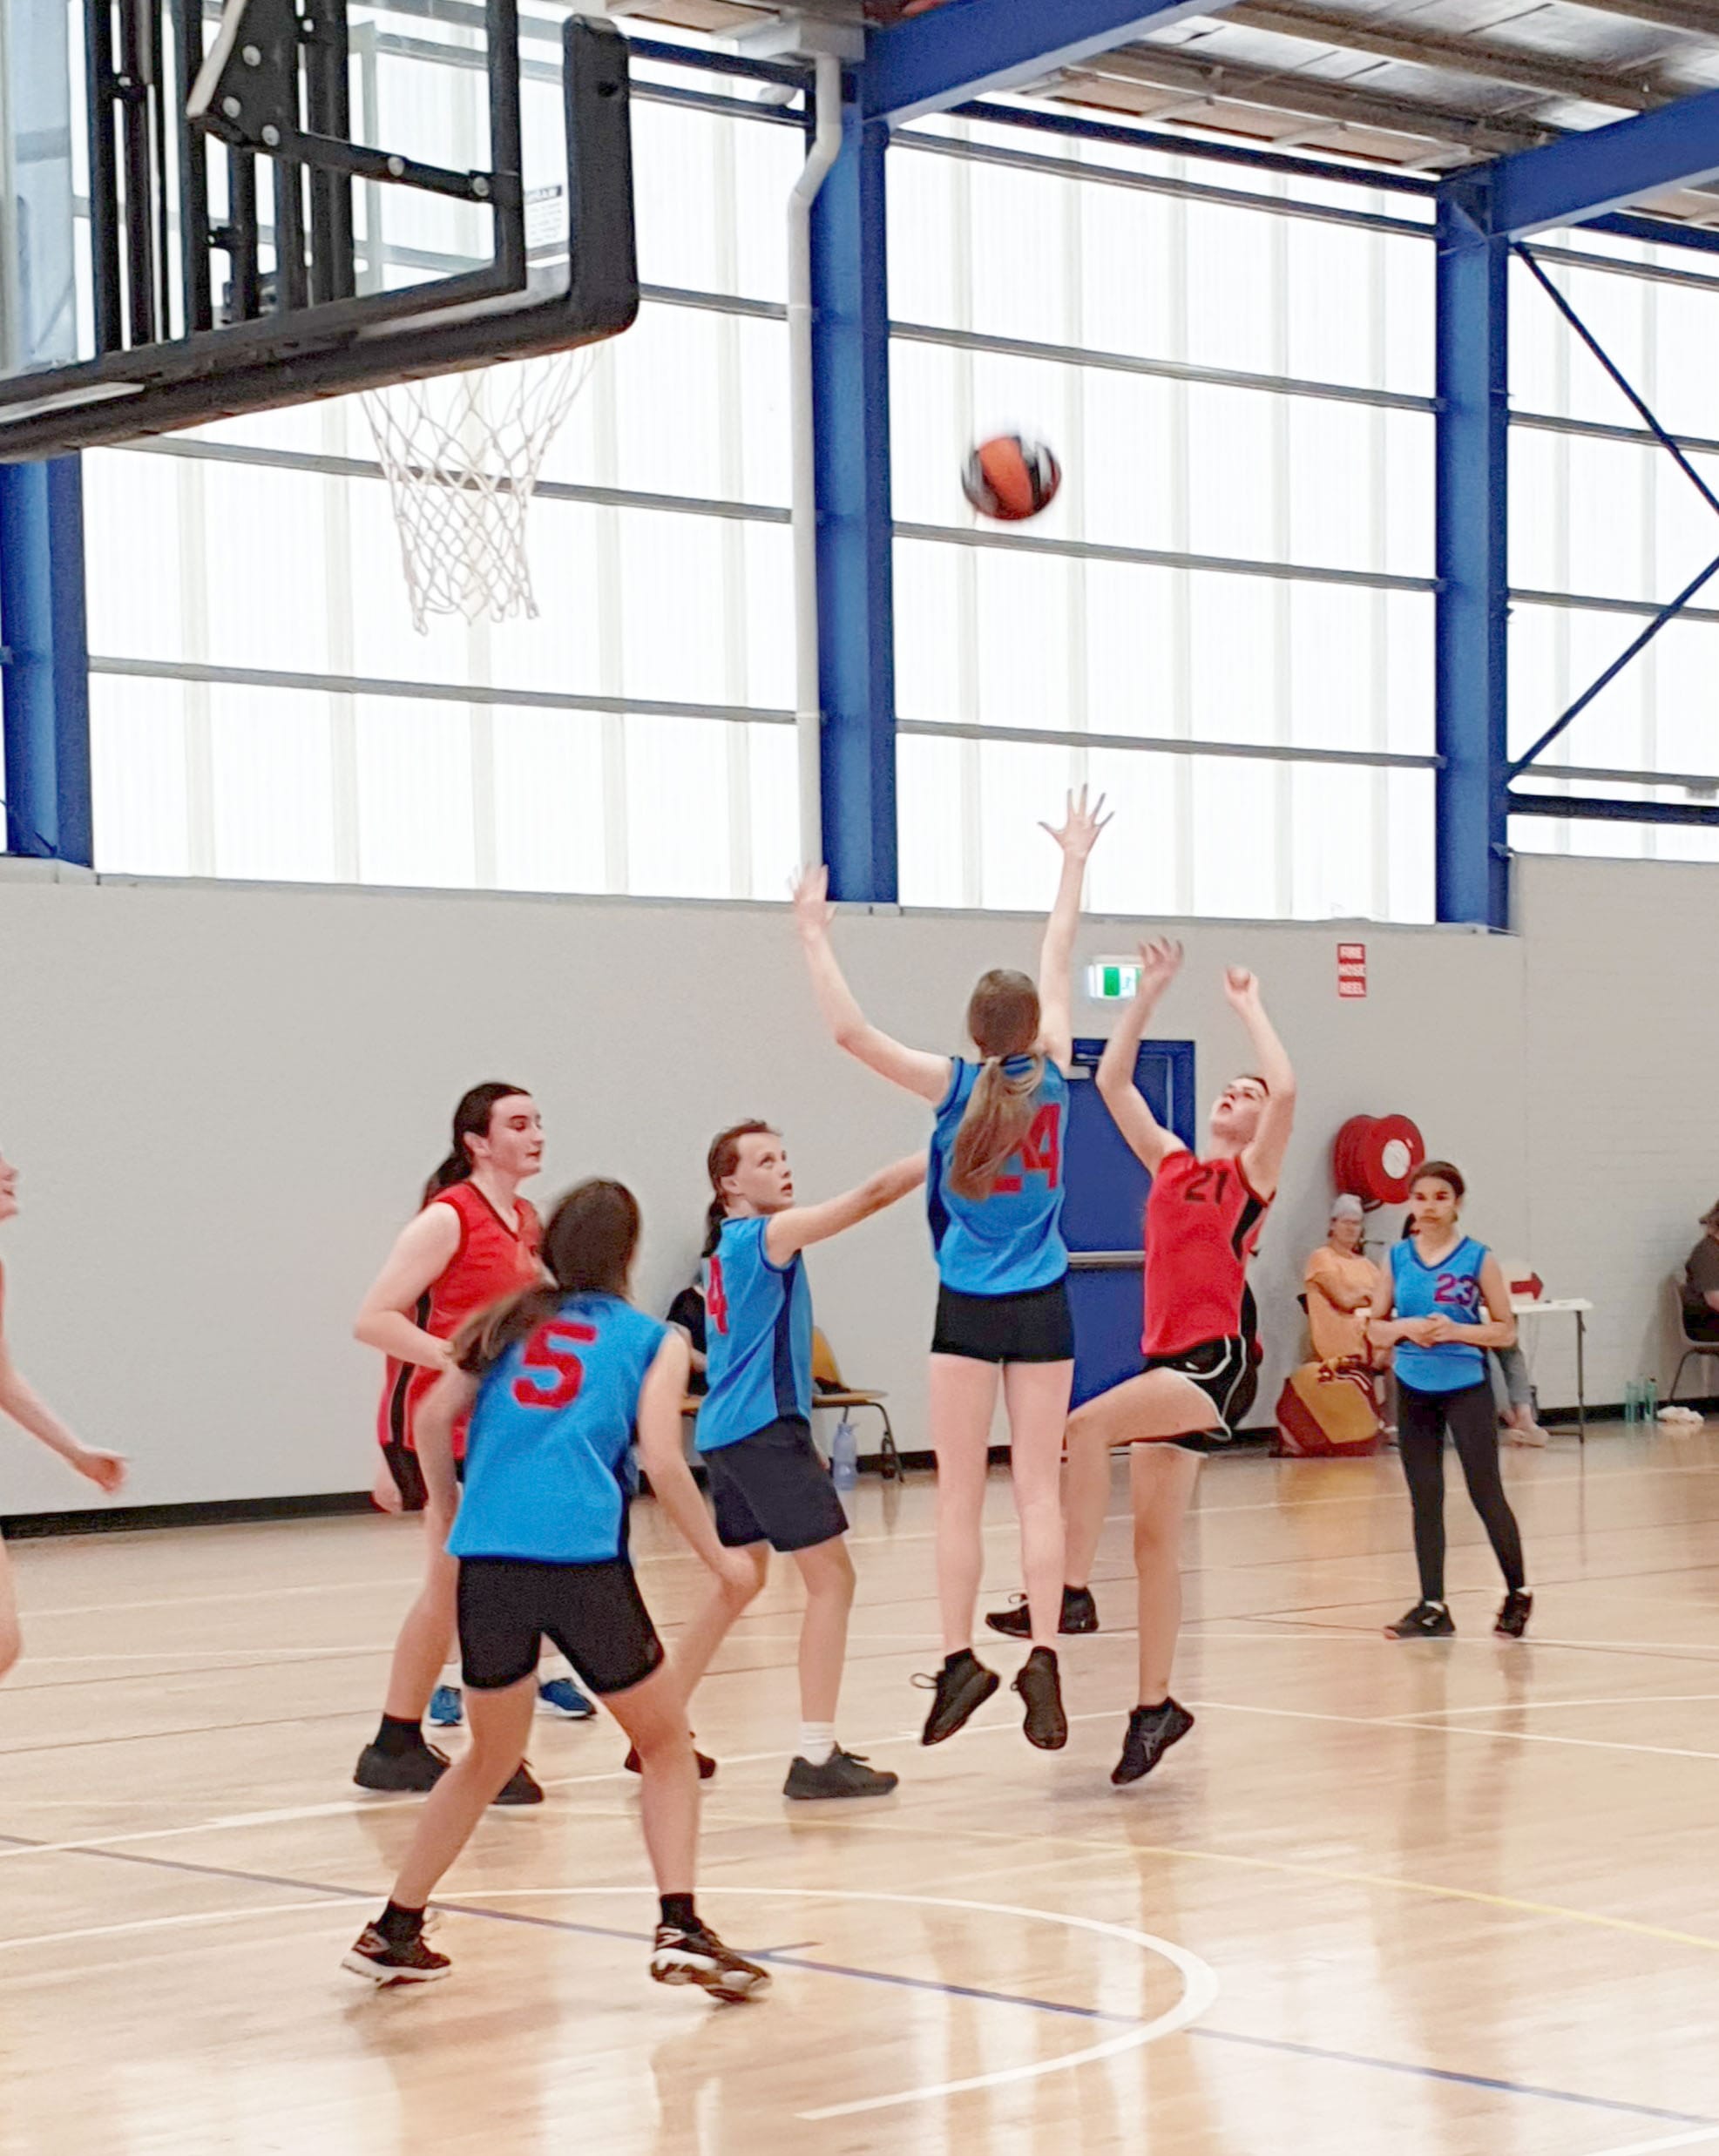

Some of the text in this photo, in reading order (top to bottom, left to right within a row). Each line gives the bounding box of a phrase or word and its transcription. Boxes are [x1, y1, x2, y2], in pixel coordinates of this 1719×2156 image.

[990, 1103, 1060, 1196] 4
[1184, 1166, 1228, 1204] 21
[707, 1254, 729, 1335] 4
[1433, 1273, 1475, 1306] 23
[512, 1319, 597, 1409] 5
